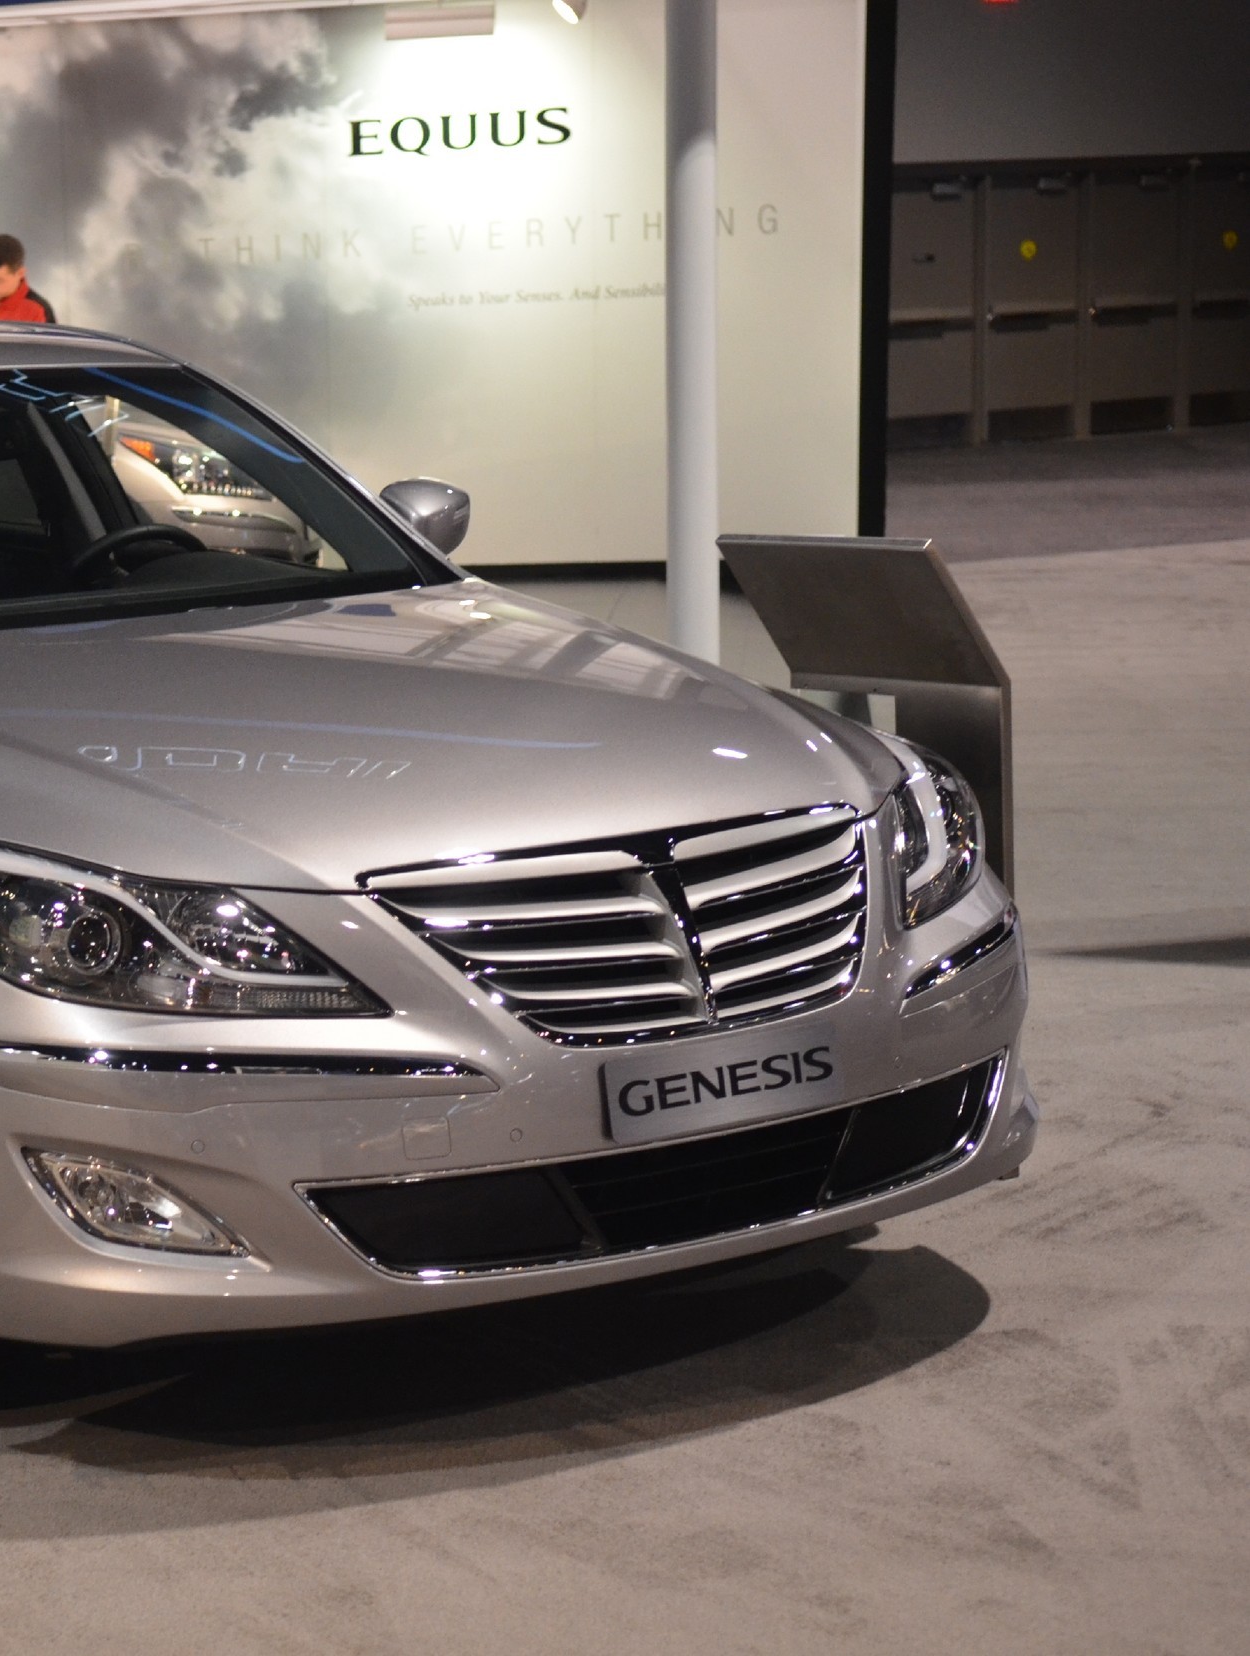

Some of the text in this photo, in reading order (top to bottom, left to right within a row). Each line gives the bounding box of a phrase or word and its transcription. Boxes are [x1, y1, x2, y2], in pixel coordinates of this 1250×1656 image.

[348, 107, 572, 157] EQUUS
[410, 203, 779, 256] EVERYTHNG
[478, 291, 510, 305] Your
[570, 286, 600, 301] And
[618, 1046, 834, 1117] GENESIS
